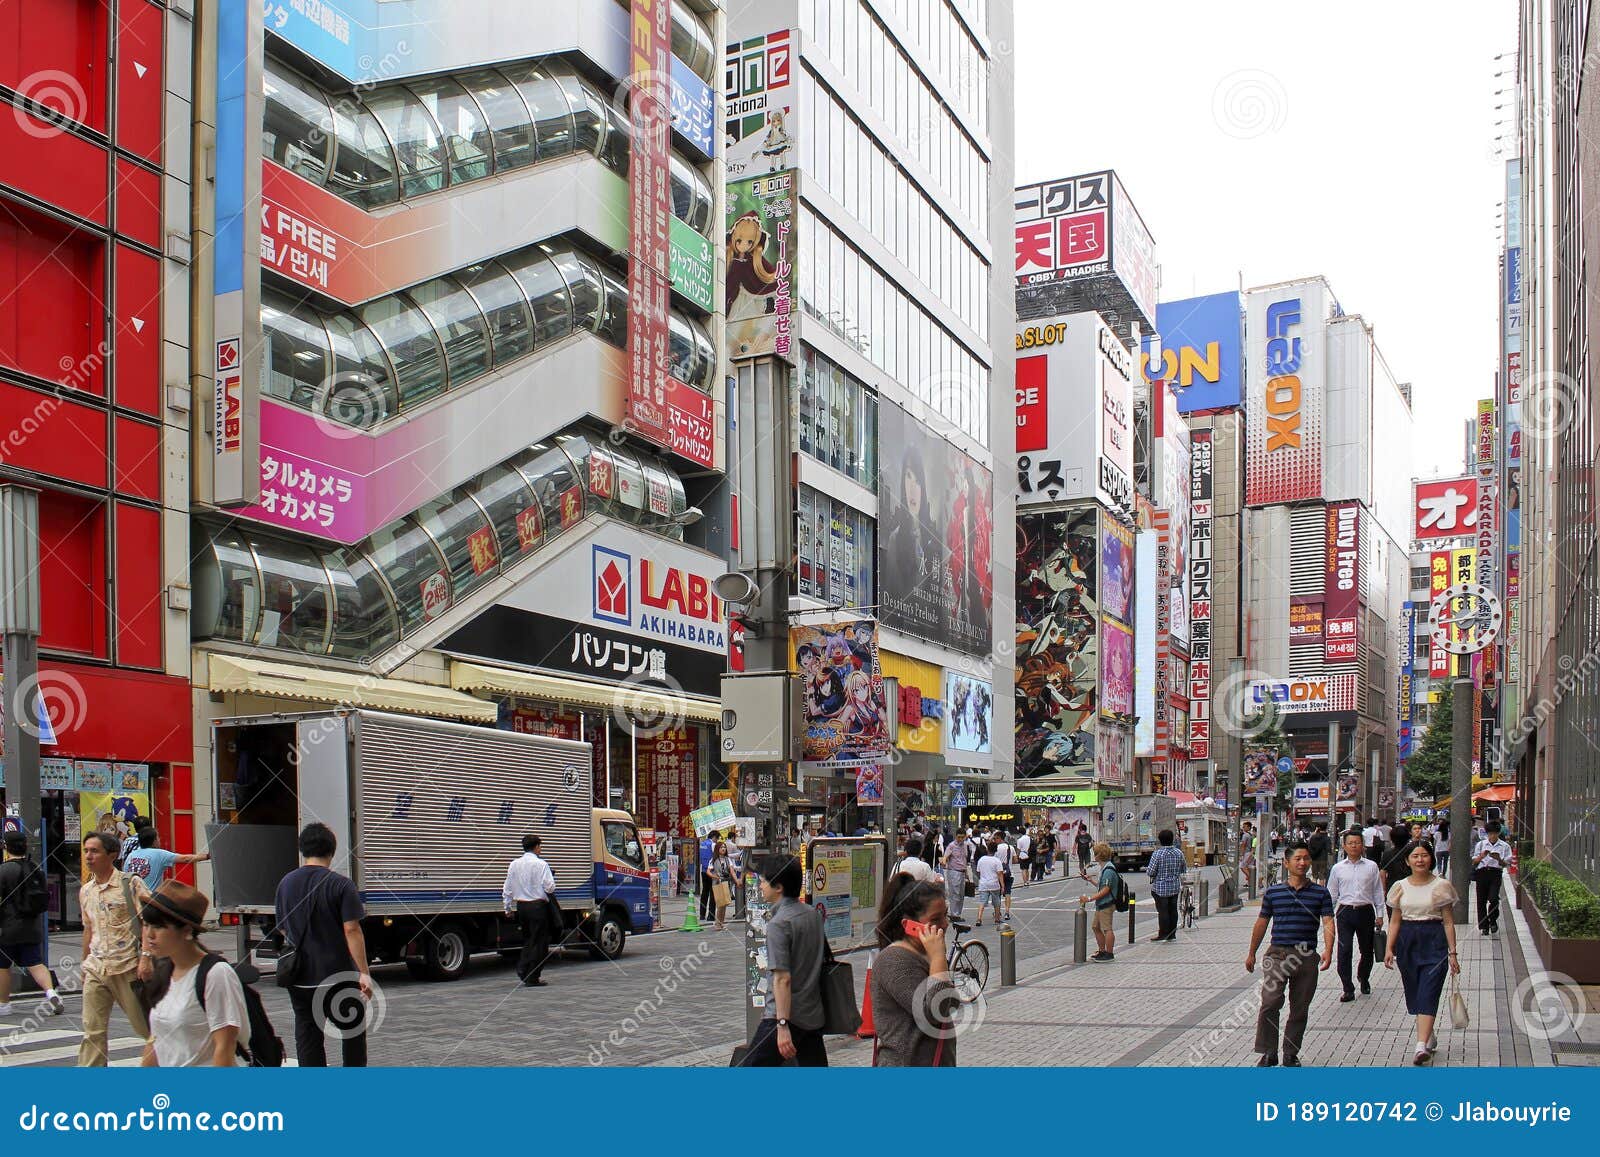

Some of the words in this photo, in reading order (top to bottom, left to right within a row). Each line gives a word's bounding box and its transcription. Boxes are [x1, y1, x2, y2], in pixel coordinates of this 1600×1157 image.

[753, 174, 791, 196] azone
[277, 210, 337, 262] FREE
[1015, 211, 1105, 271] 天国
[1021, 271, 1057, 285] HOBBY
[1057, 263, 1109, 280] PARADISE
[225, 375, 241, 452] LABI
[1192, 432, 1202, 498] PARADISE
[1201, 432, 1211, 475] HOBBY
[261, 456, 352, 503] タルカメラ
[261, 488, 335, 527] オカメラ
[652, 499, 668, 513] FREE
[1329, 508, 1338, 545] Flagship
[1479, 485, 1492, 557] TAKARADA
[1338, 507, 1358, 549] Duty
[1328, 547, 1337, 573] Store
[1337, 550, 1355, 591] Free
[1432, 557, 1448, 590] 免税
[640, 558, 724, 624] LABI
[640, 613, 724, 648] AKIHABARA
[1191, 519, 1211, 759] ボークス秋葉原ホビー天国
[1327, 642, 1354, 654] 면세점
[1328, 621, 1354, 635] 免税
[1401, 608, 1412, 667] Panasonic
[571, 632, 666, 681] パソコン館
[1401, 673, 1411, 721] ONODEN
